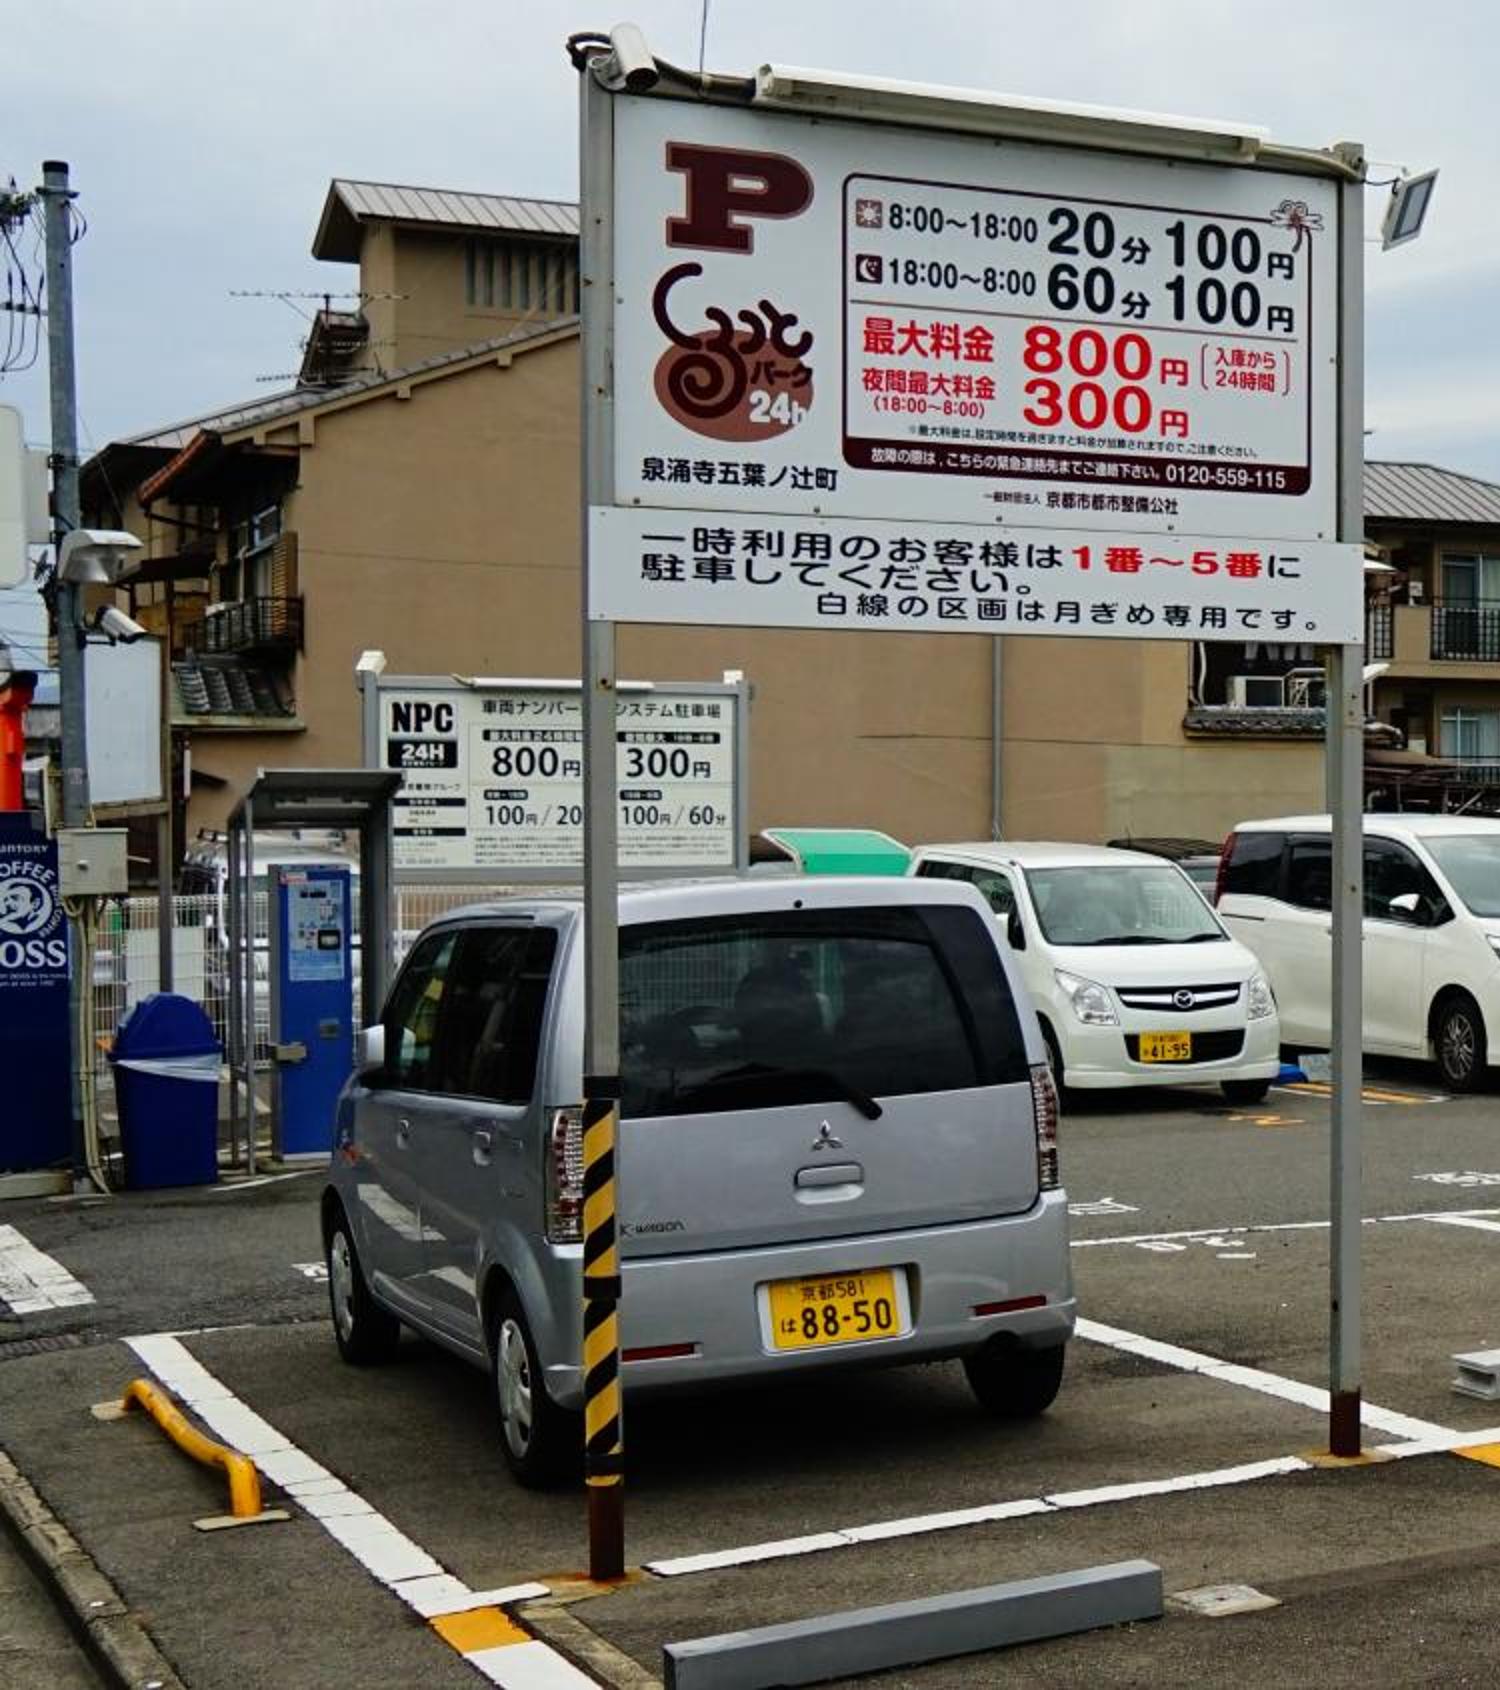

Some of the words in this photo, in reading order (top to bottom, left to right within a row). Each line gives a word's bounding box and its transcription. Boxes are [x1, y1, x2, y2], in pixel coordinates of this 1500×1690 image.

[666, 141, 814, 255] P
[863, 317, 994, 363] 最大料金
[1215, 347, 1276, 370] 入庫から
[751, 360, 813, 388] パーク
[862, 368, 996, 400] 夜間最大料金
[1215, 369, 1275, 393] 24時間
[641, 457, 838, 491] 泉涌寺五葉ノ辻町
[1165, 464, 1286, 489] 0120-559-115
[1046, 491, 1179, 515] 京都市都市整備公社
[640, 553, 1032, 595] 駐車してください。
[817, 593, 1316, 632] 白線の区画は月ぎめ専用です。
[391, 702, 453, 733] NPC
[401, 743, 445, 761] 24H
[0, 861, 55, 884] OFFEE
[0, 940, 66, 968] OSS
[781, 1317, 797, 1334] は
[801, 1298, 892, 1339] 88-50
